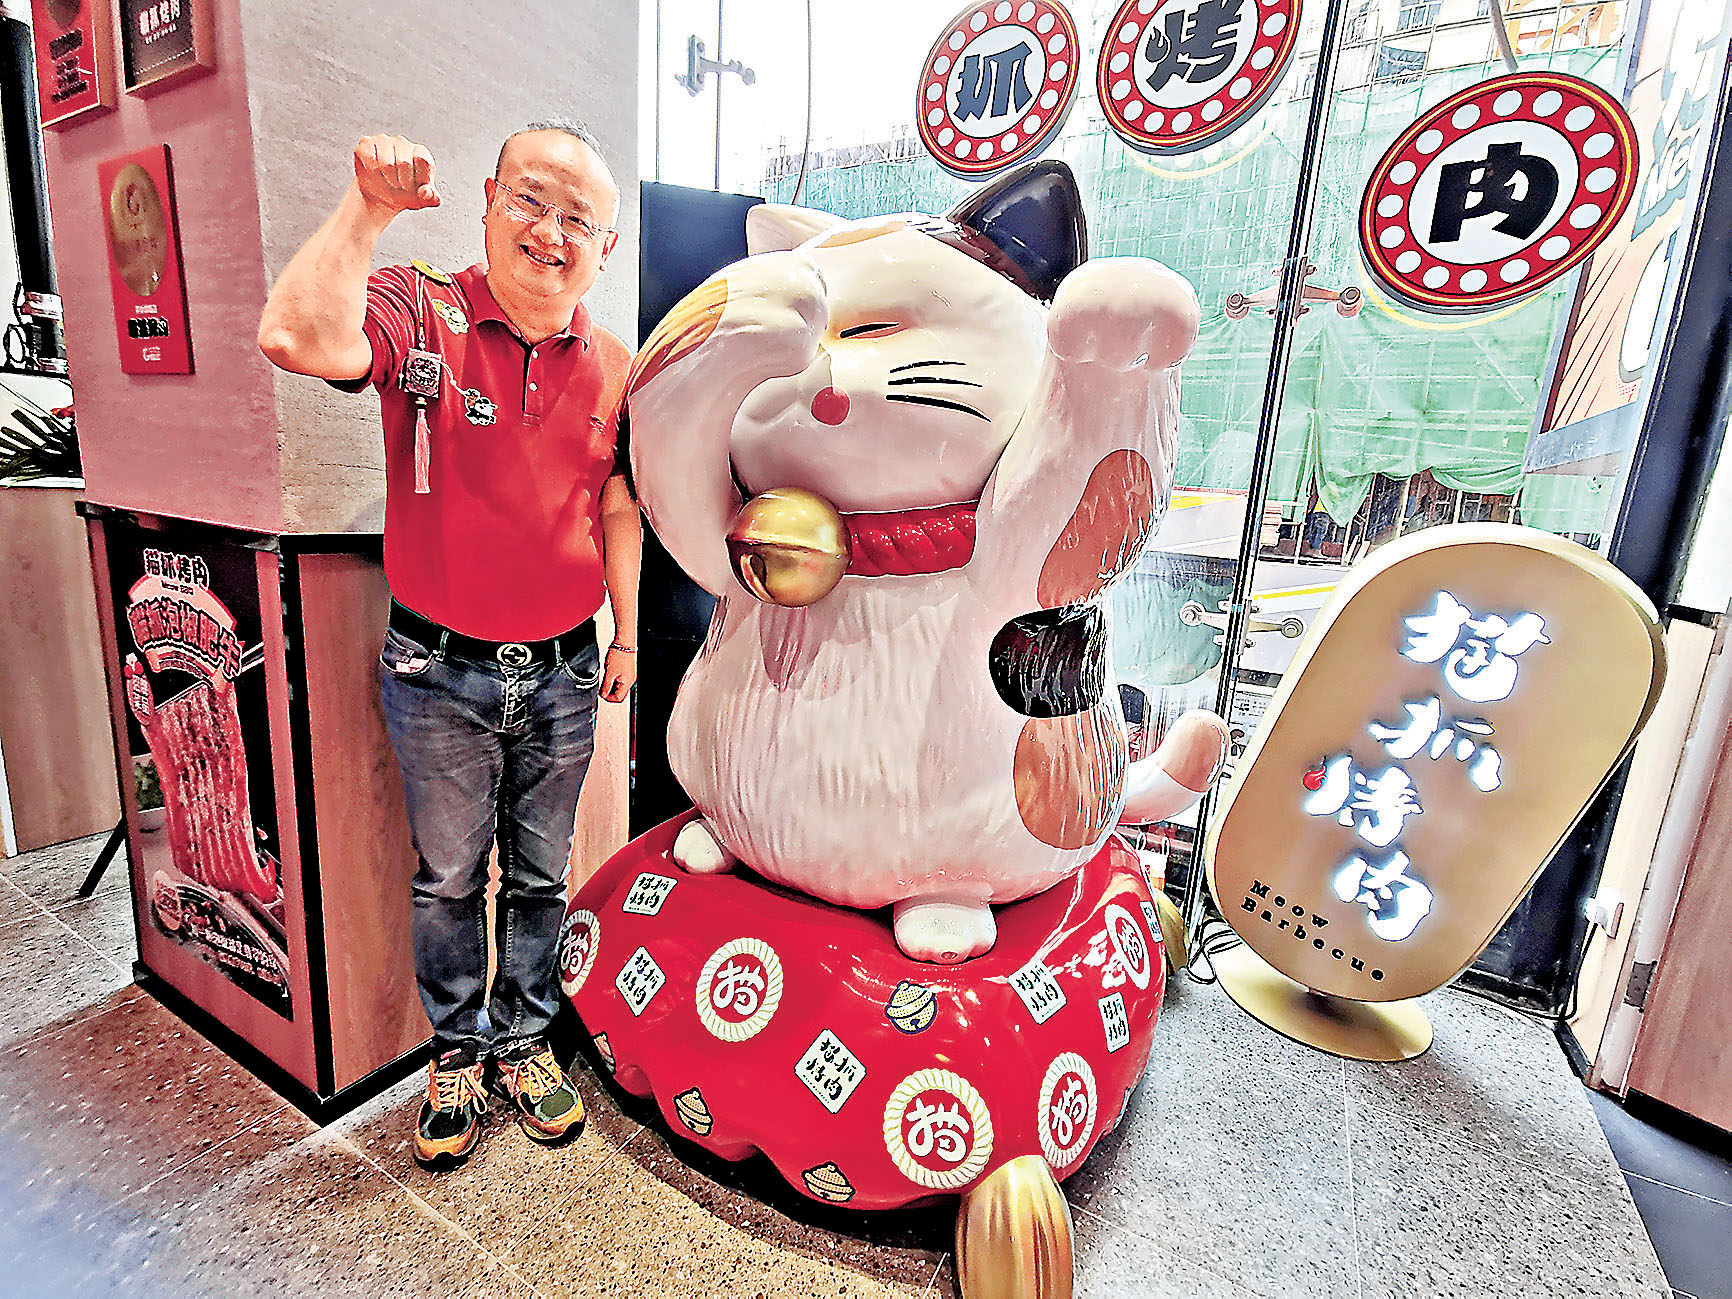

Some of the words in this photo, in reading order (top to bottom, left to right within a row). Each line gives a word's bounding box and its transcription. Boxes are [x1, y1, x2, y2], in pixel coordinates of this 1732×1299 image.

[954, 41, 1032, 122] 抓
[1146, 0, 1243, 92] 烤
[1428, 142, 1559, 244] 肉
[1303, 589, 1551, 942] 猫抓烤肉
[1239, 895, 1386, 983] Barbecue
[1248, 878, 1330, 930] Meow
